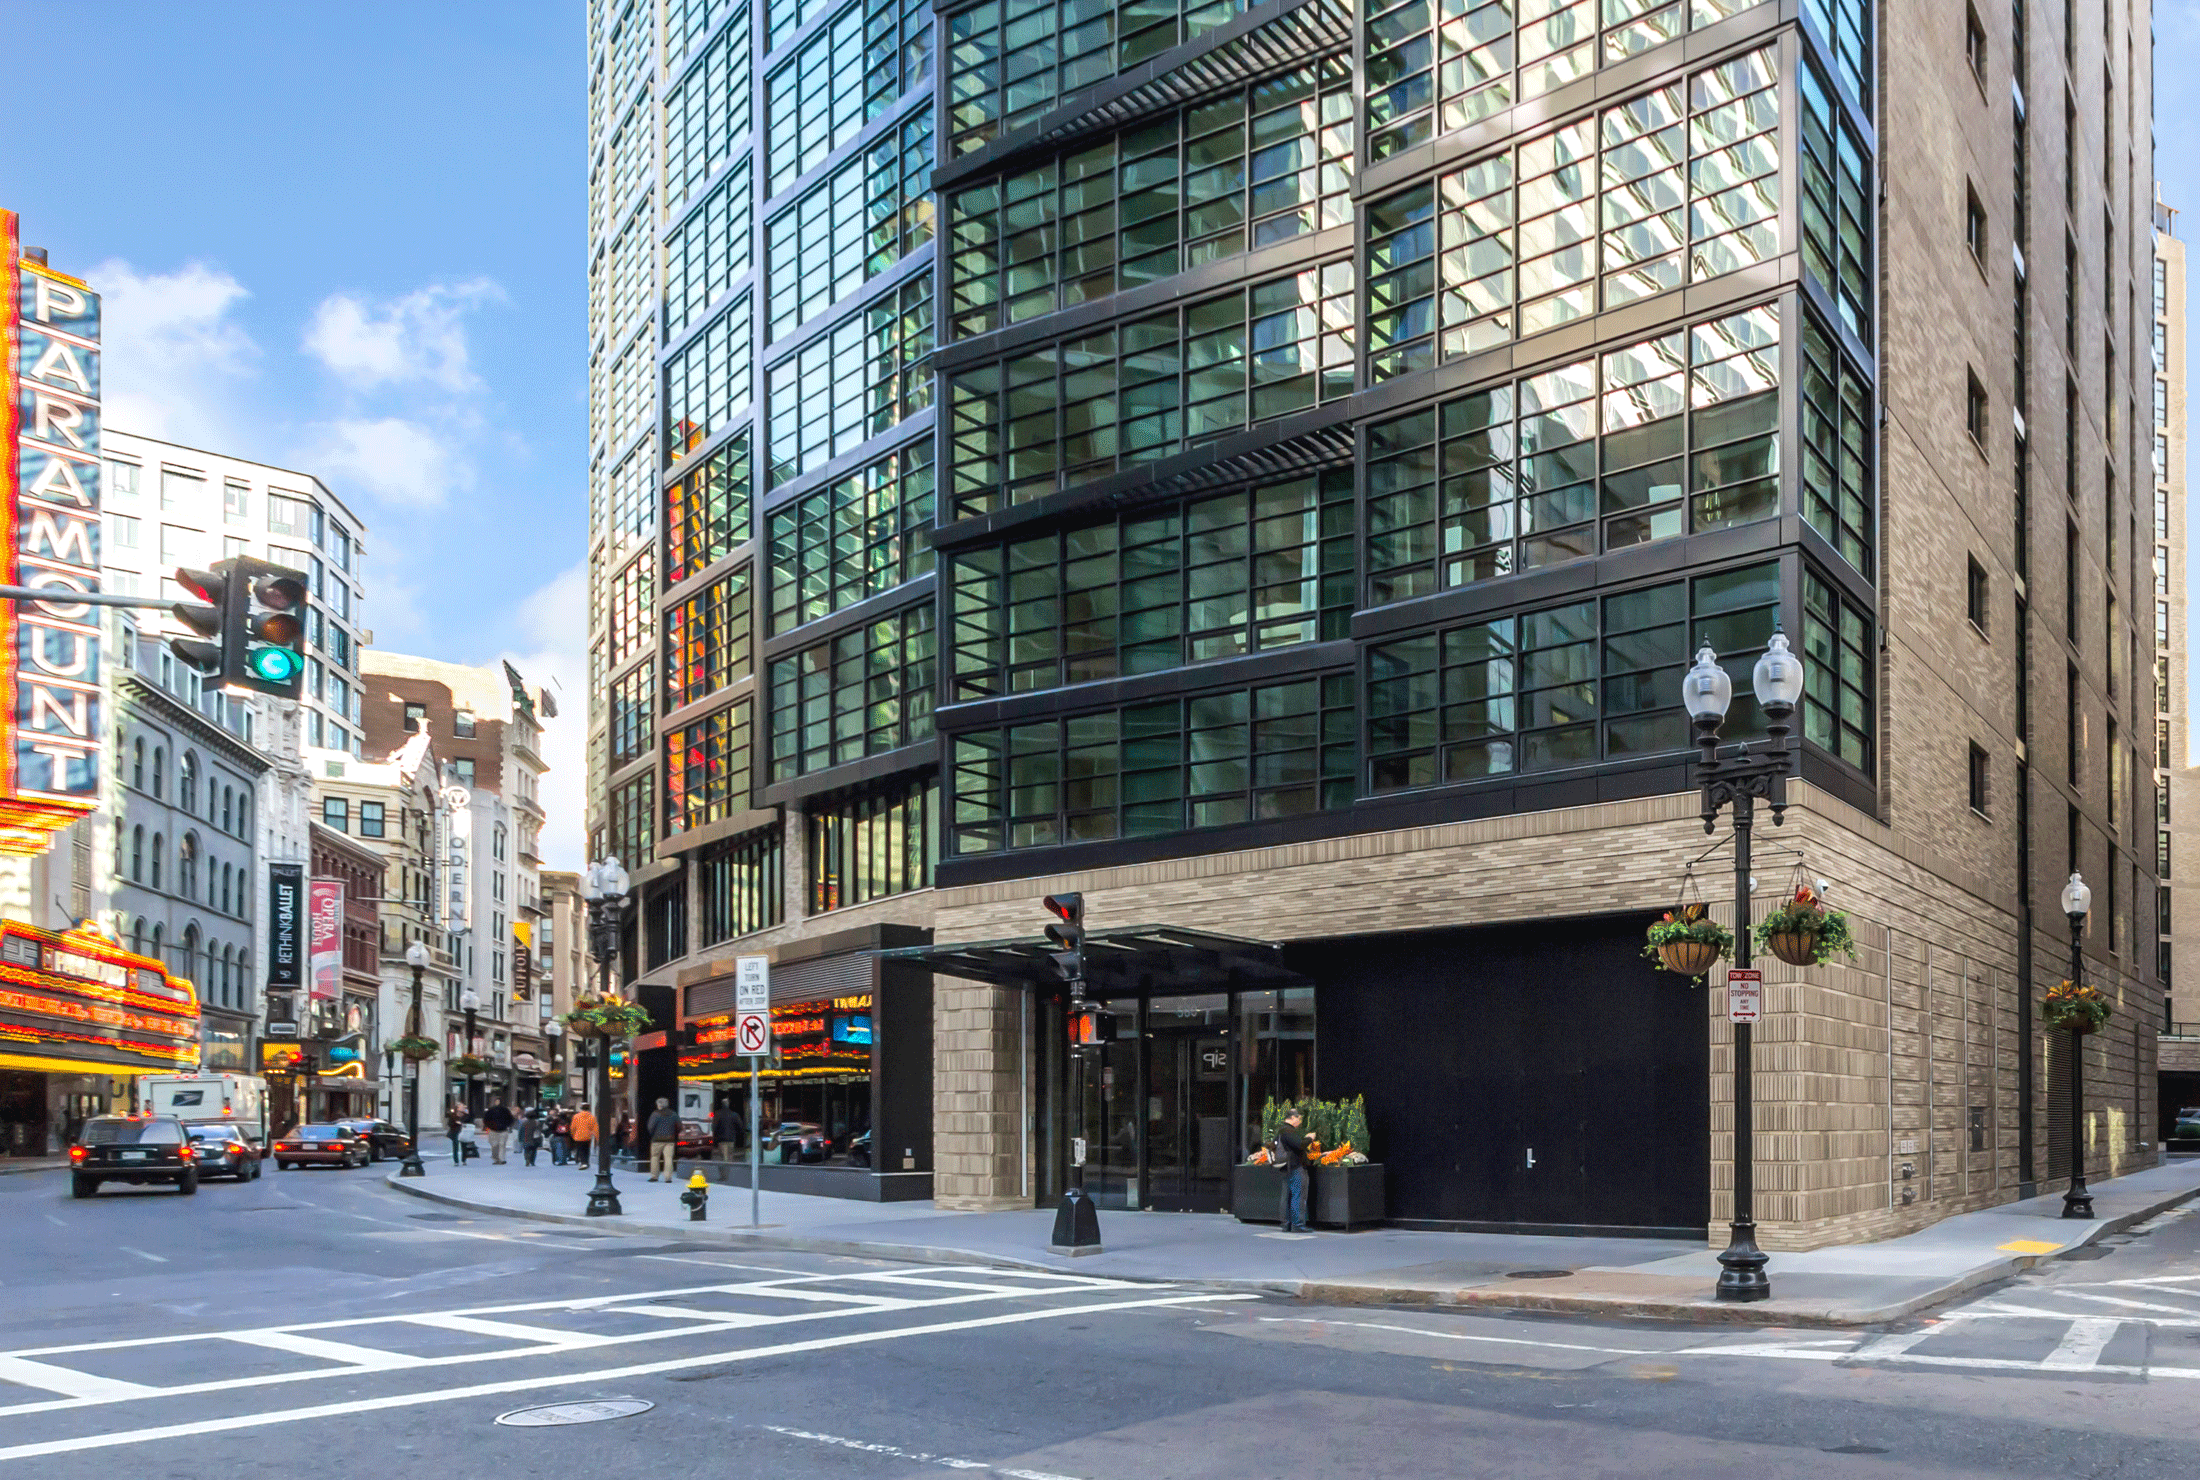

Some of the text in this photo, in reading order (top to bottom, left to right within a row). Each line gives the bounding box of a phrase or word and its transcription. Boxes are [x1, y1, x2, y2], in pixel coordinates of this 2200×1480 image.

[27, 277, 95, 792] PARAMOUNT
[278, 884, 294, 964] RETHINKBALLET
[312, 912, 323, 947] HOUSE
[322, 897, 335, 940] OPERA
[515, 944, 527, 995] SUFFOLK
[745, 962, 759, 971] LEFT
[745, 973, 760, 981] TURN
[740, 984, 765, 995] ON RED
